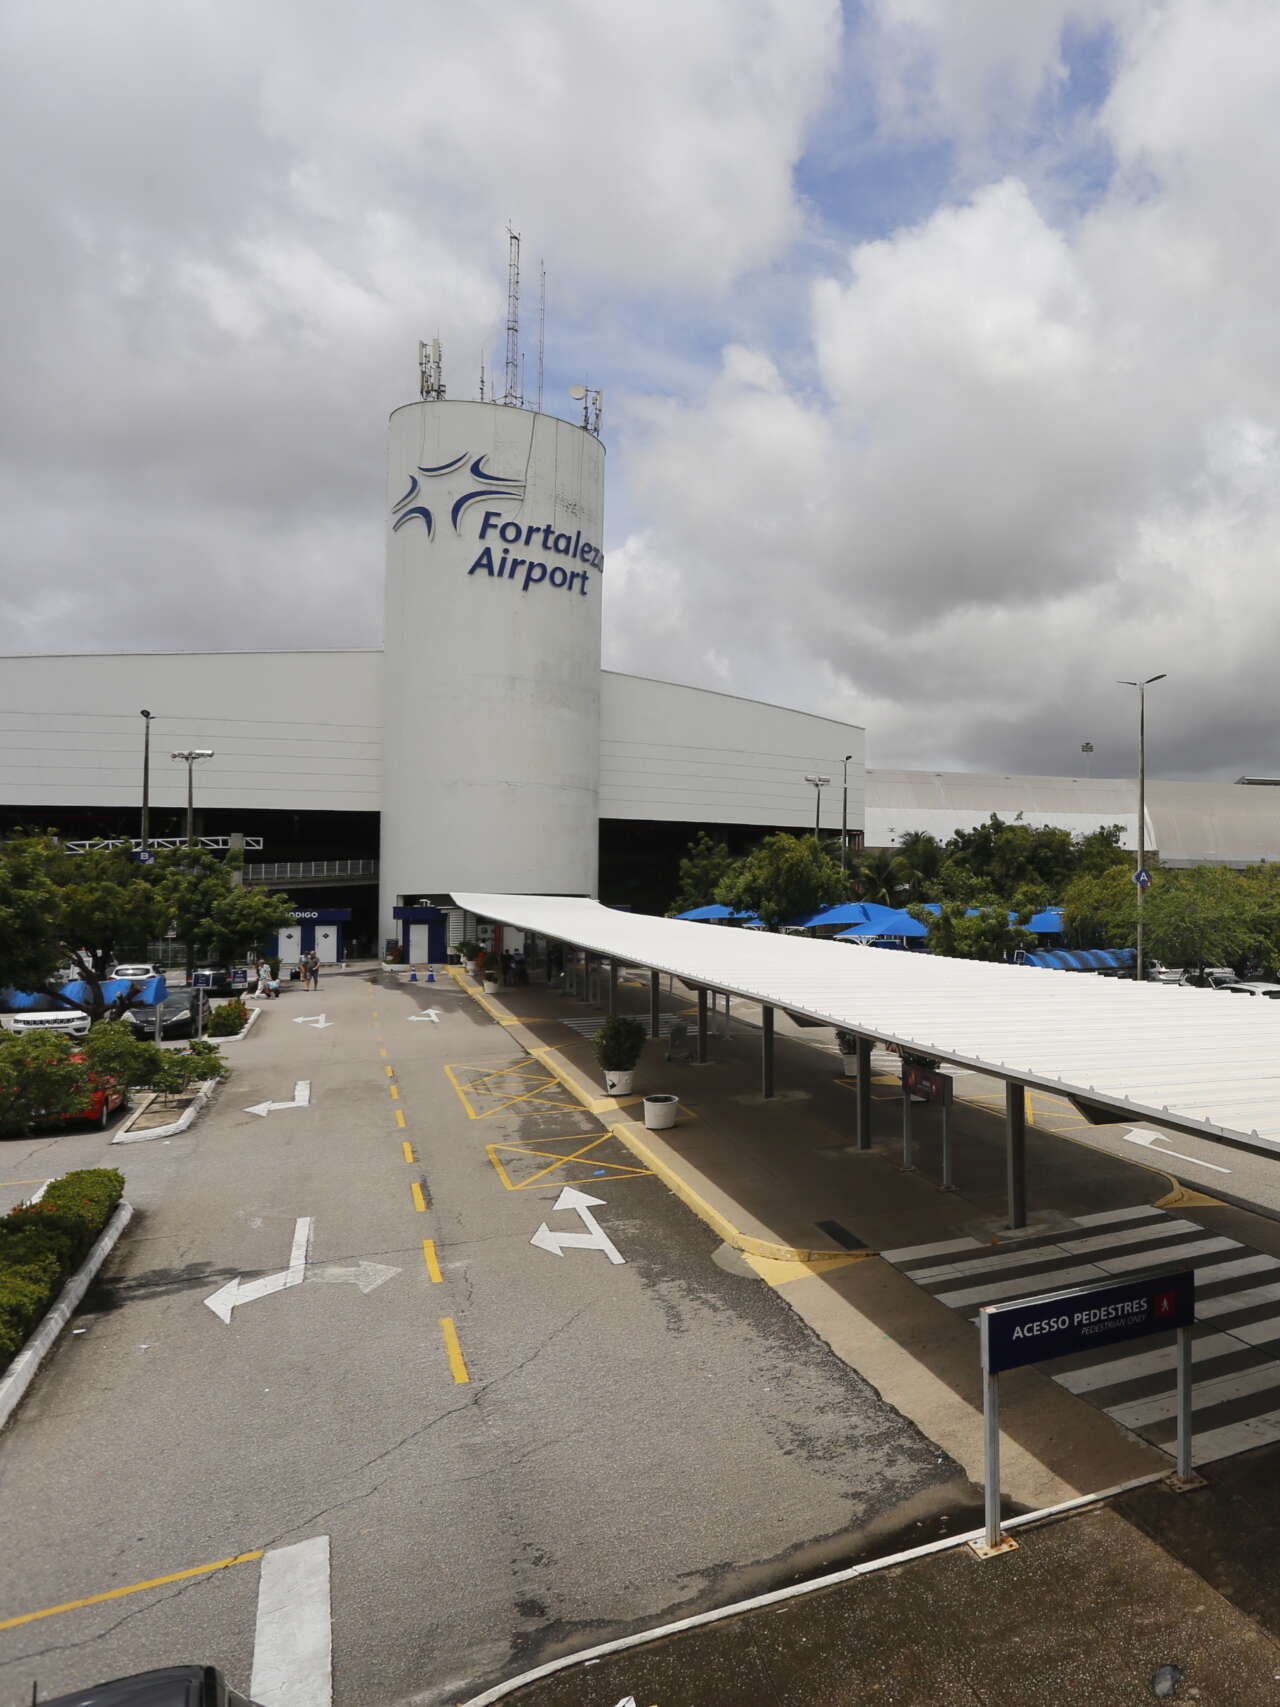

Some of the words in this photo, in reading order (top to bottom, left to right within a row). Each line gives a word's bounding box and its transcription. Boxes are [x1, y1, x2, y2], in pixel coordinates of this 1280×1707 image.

[467, 546, 590, 596] Airport
[1140, 872, 1148, 881] A
[1012, 1316, 1069, 1341] ACESSO
[1073, 1298, 1148, 1326] PEDESTRES
[1081, 1317, 1127, 1336] PEDESTRIAN
[1127, 1313, 1147, 1327] ONLY
